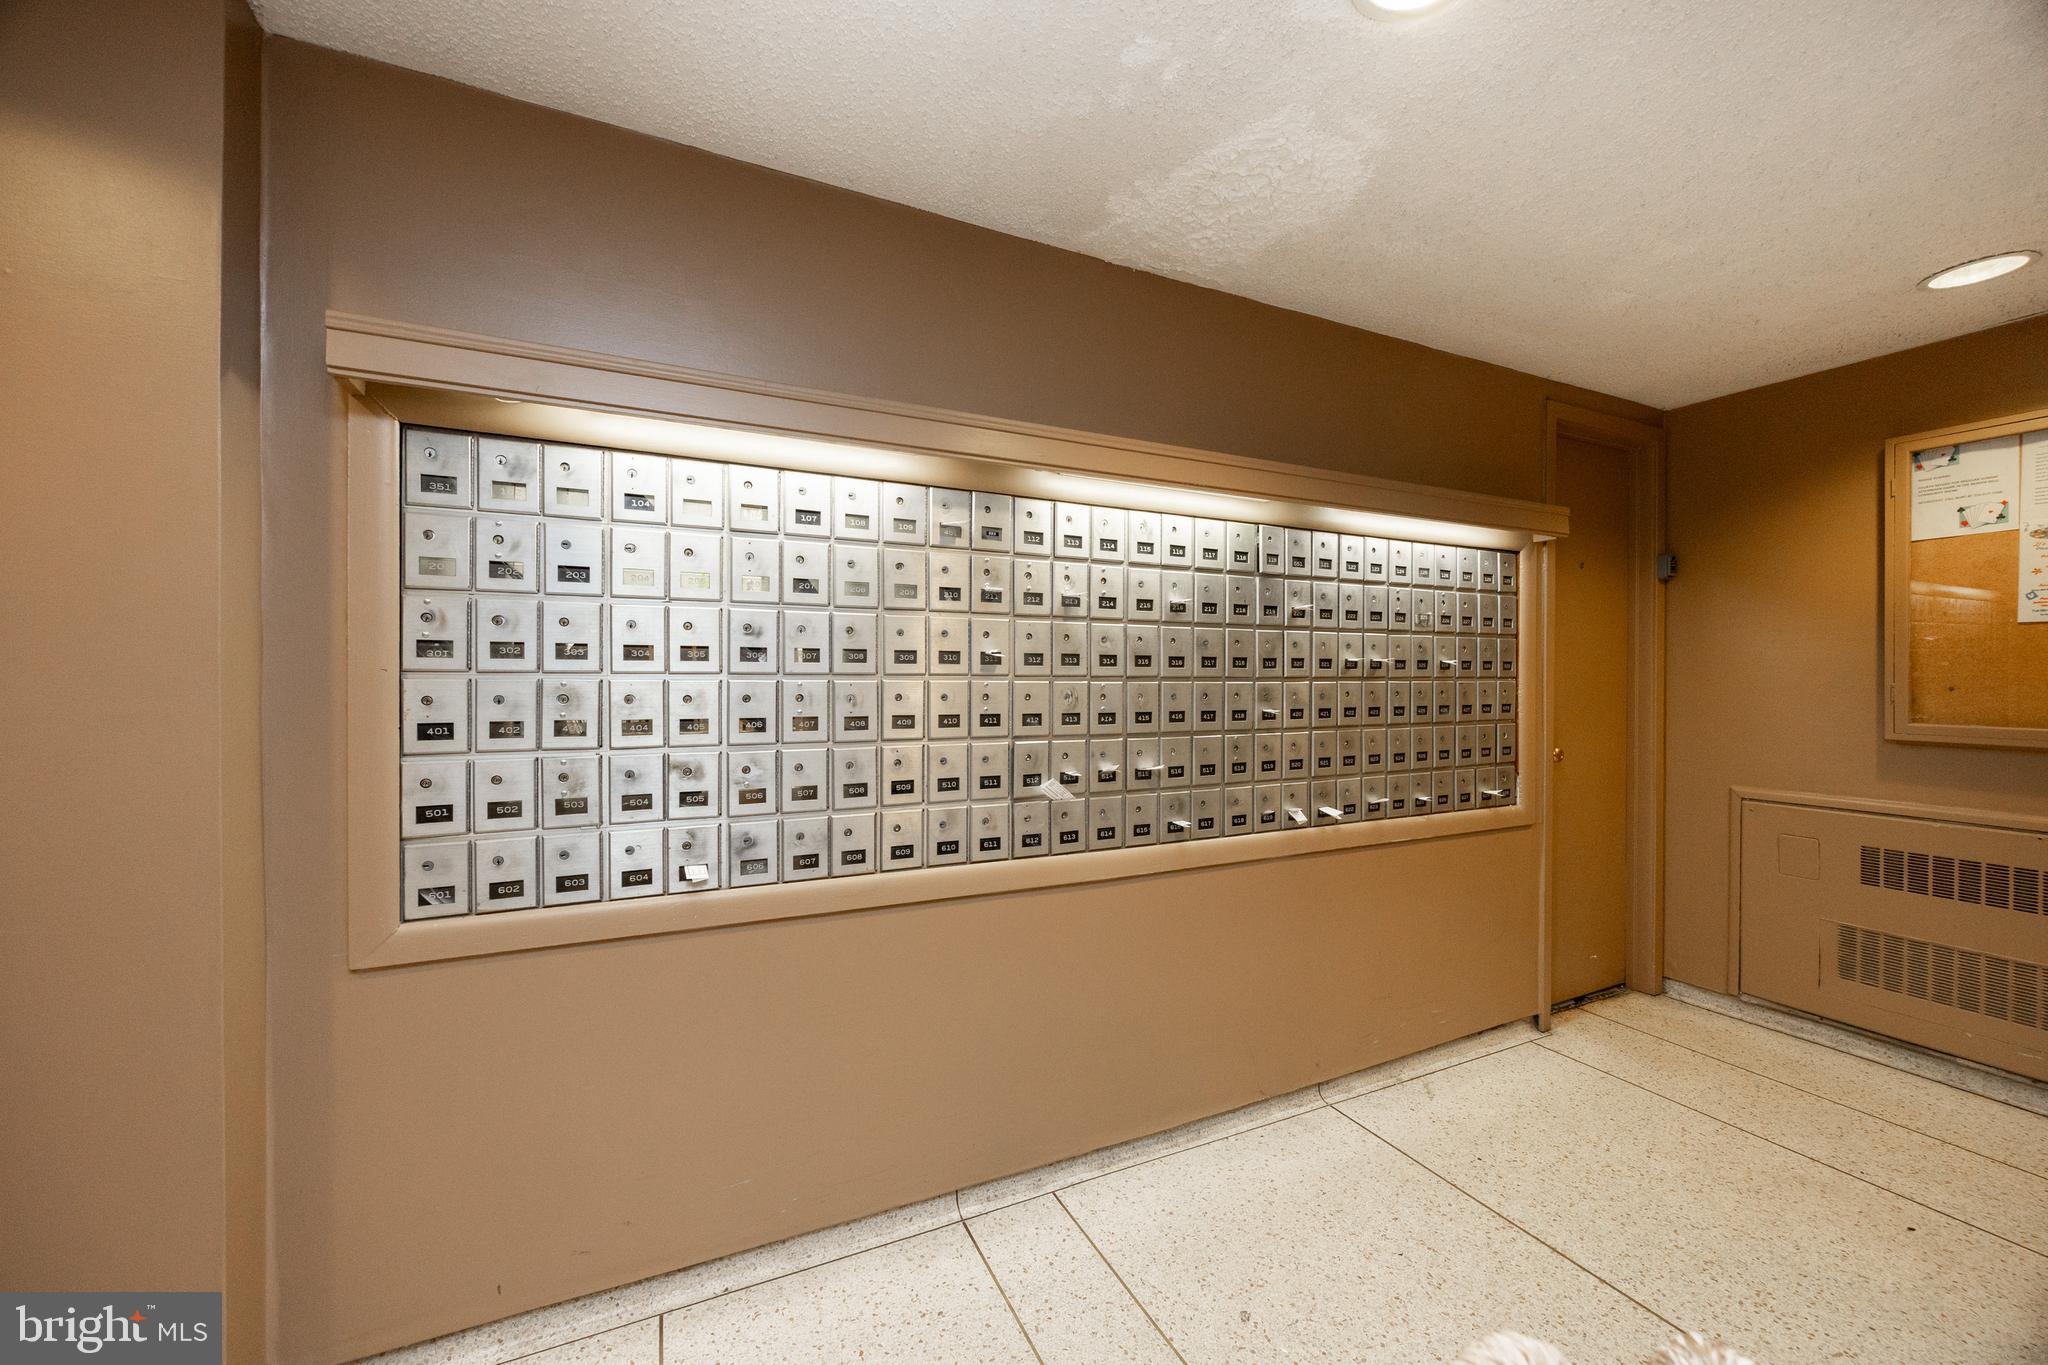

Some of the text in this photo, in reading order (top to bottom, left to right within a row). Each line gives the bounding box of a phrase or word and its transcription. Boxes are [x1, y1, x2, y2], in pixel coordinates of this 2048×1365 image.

[429, 482, 452, 491] 351
[565, 571, 586, 579] 203
[427, 727, 449, 735] 401
[498, 726, 520, 734] 402
[425, 809, 449, 817] 501
[496, 806, 519, 814] 502
[746, 863, 764, 871] 606
[629, 874, 648, 882] 604
[564, 879, 585, 887] 603
[498, 885, 520, 893] 602
